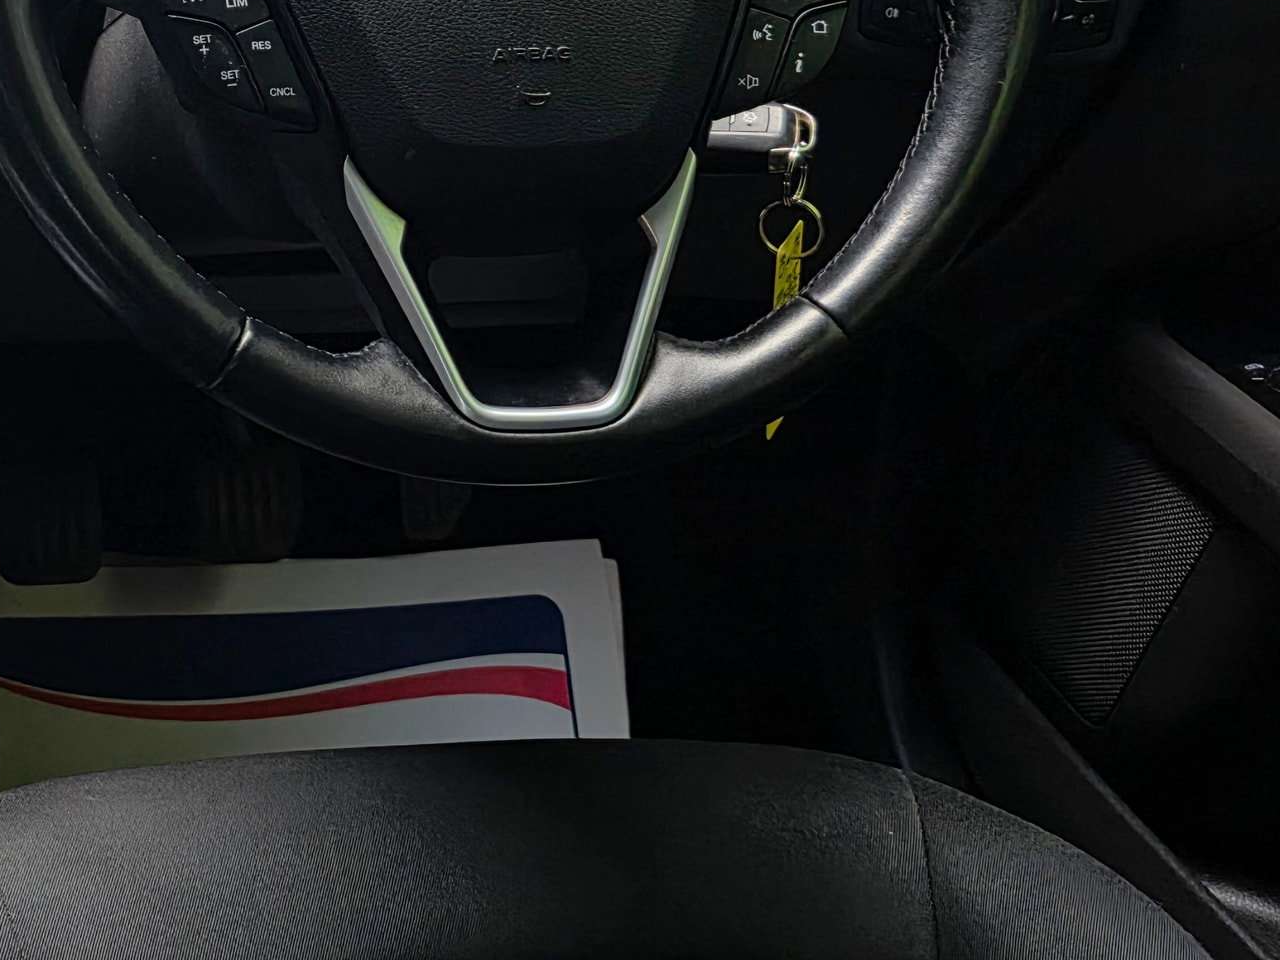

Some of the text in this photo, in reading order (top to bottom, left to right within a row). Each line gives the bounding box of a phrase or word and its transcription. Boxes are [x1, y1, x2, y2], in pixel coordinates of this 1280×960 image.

[192, 34, 212, 44] SET
[251, 40, 271, 51] RES
[492, 46, 571, 61] AIRBAG
[220, 69, 240, 80] SET
[269, 87, 296, 97] CNCL
